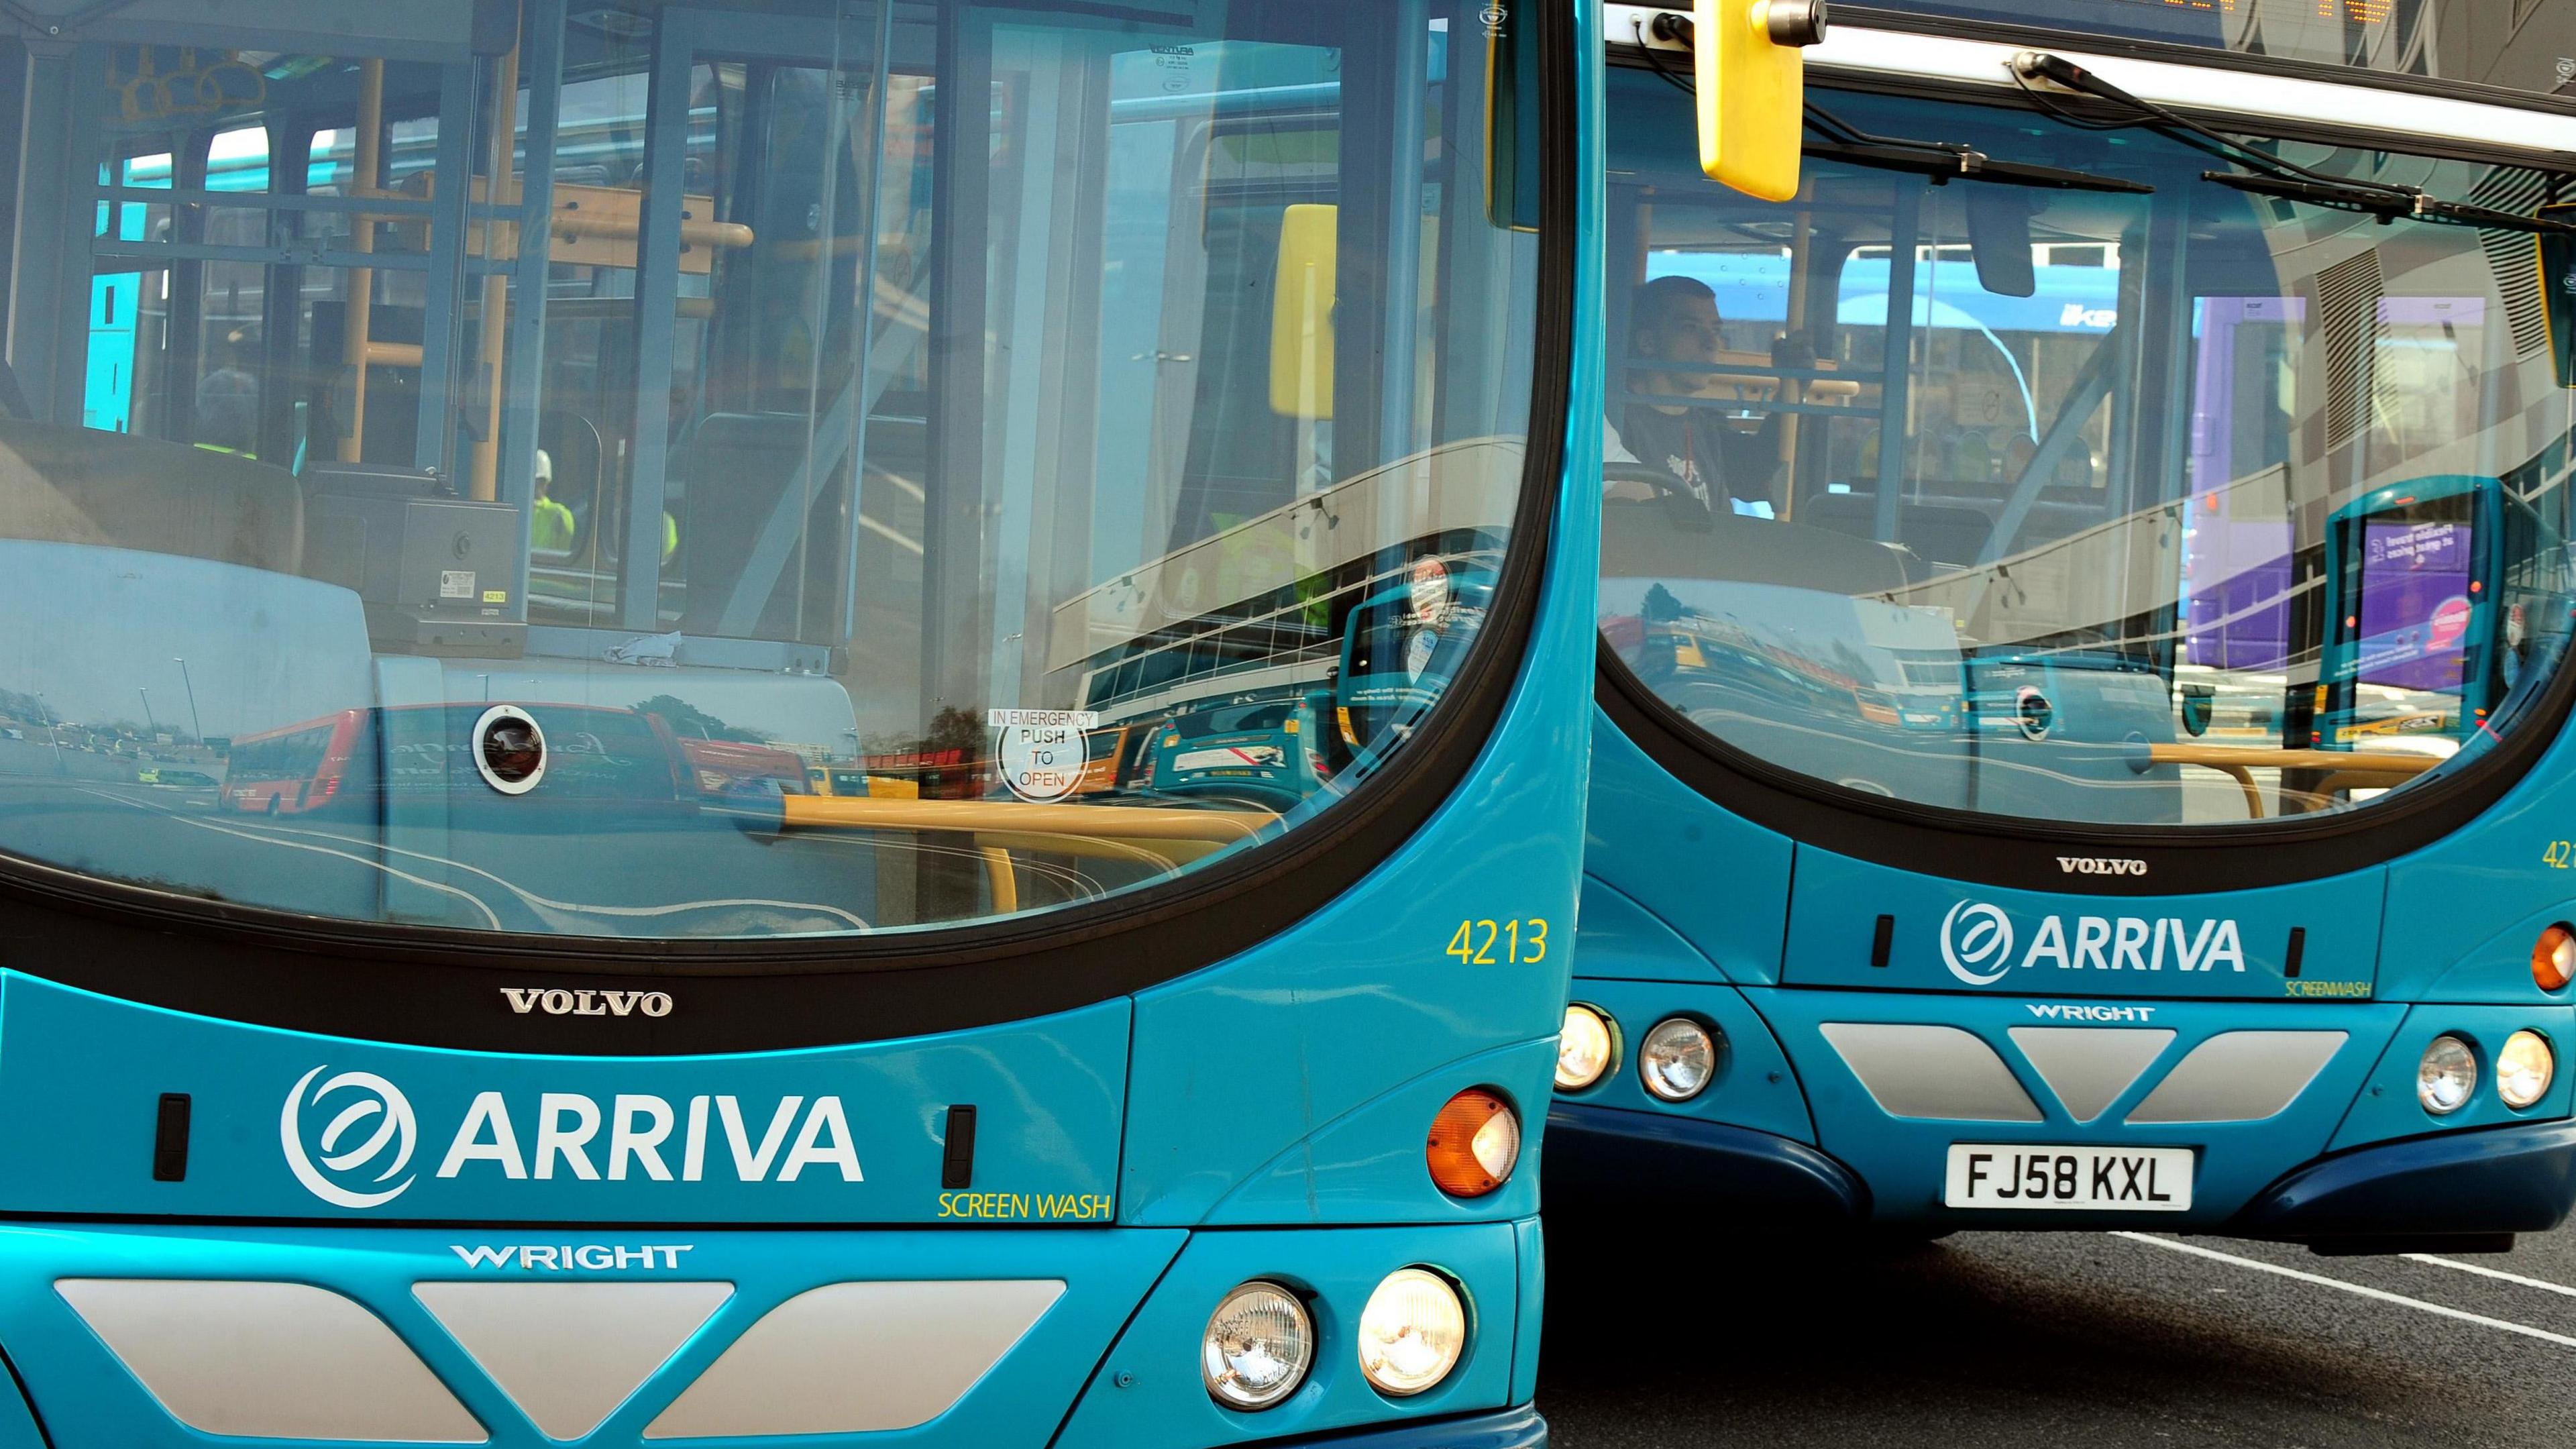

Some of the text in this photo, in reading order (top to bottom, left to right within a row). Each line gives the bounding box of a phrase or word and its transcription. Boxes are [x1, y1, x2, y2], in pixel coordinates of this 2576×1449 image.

[994, 710, 1095, 727] IN EMERGENCY
[1021, 729, 1065, 744] PUSH
[1032, 751, 1054, 765] TO
[1019, 771, 1065, 787] OPEN
[2056, 857, 2148, 875] VOLVO
[1446, 918, 1549, 964] 4213
[2021, 916, 2246, 973] ARRIVA
[499, 987, 674, 1017] VOLVO
[2026, 1004, 2155, 1022] WRIGHT
[435, 1091, 864, 1183] ARRIVA
[1967, 1154, 2171, 1201] FJ58 KXL
[938, 1193, 1111, 1219] SCREEN WASH
[450, 1244, 694, 1271] WRIGHT
